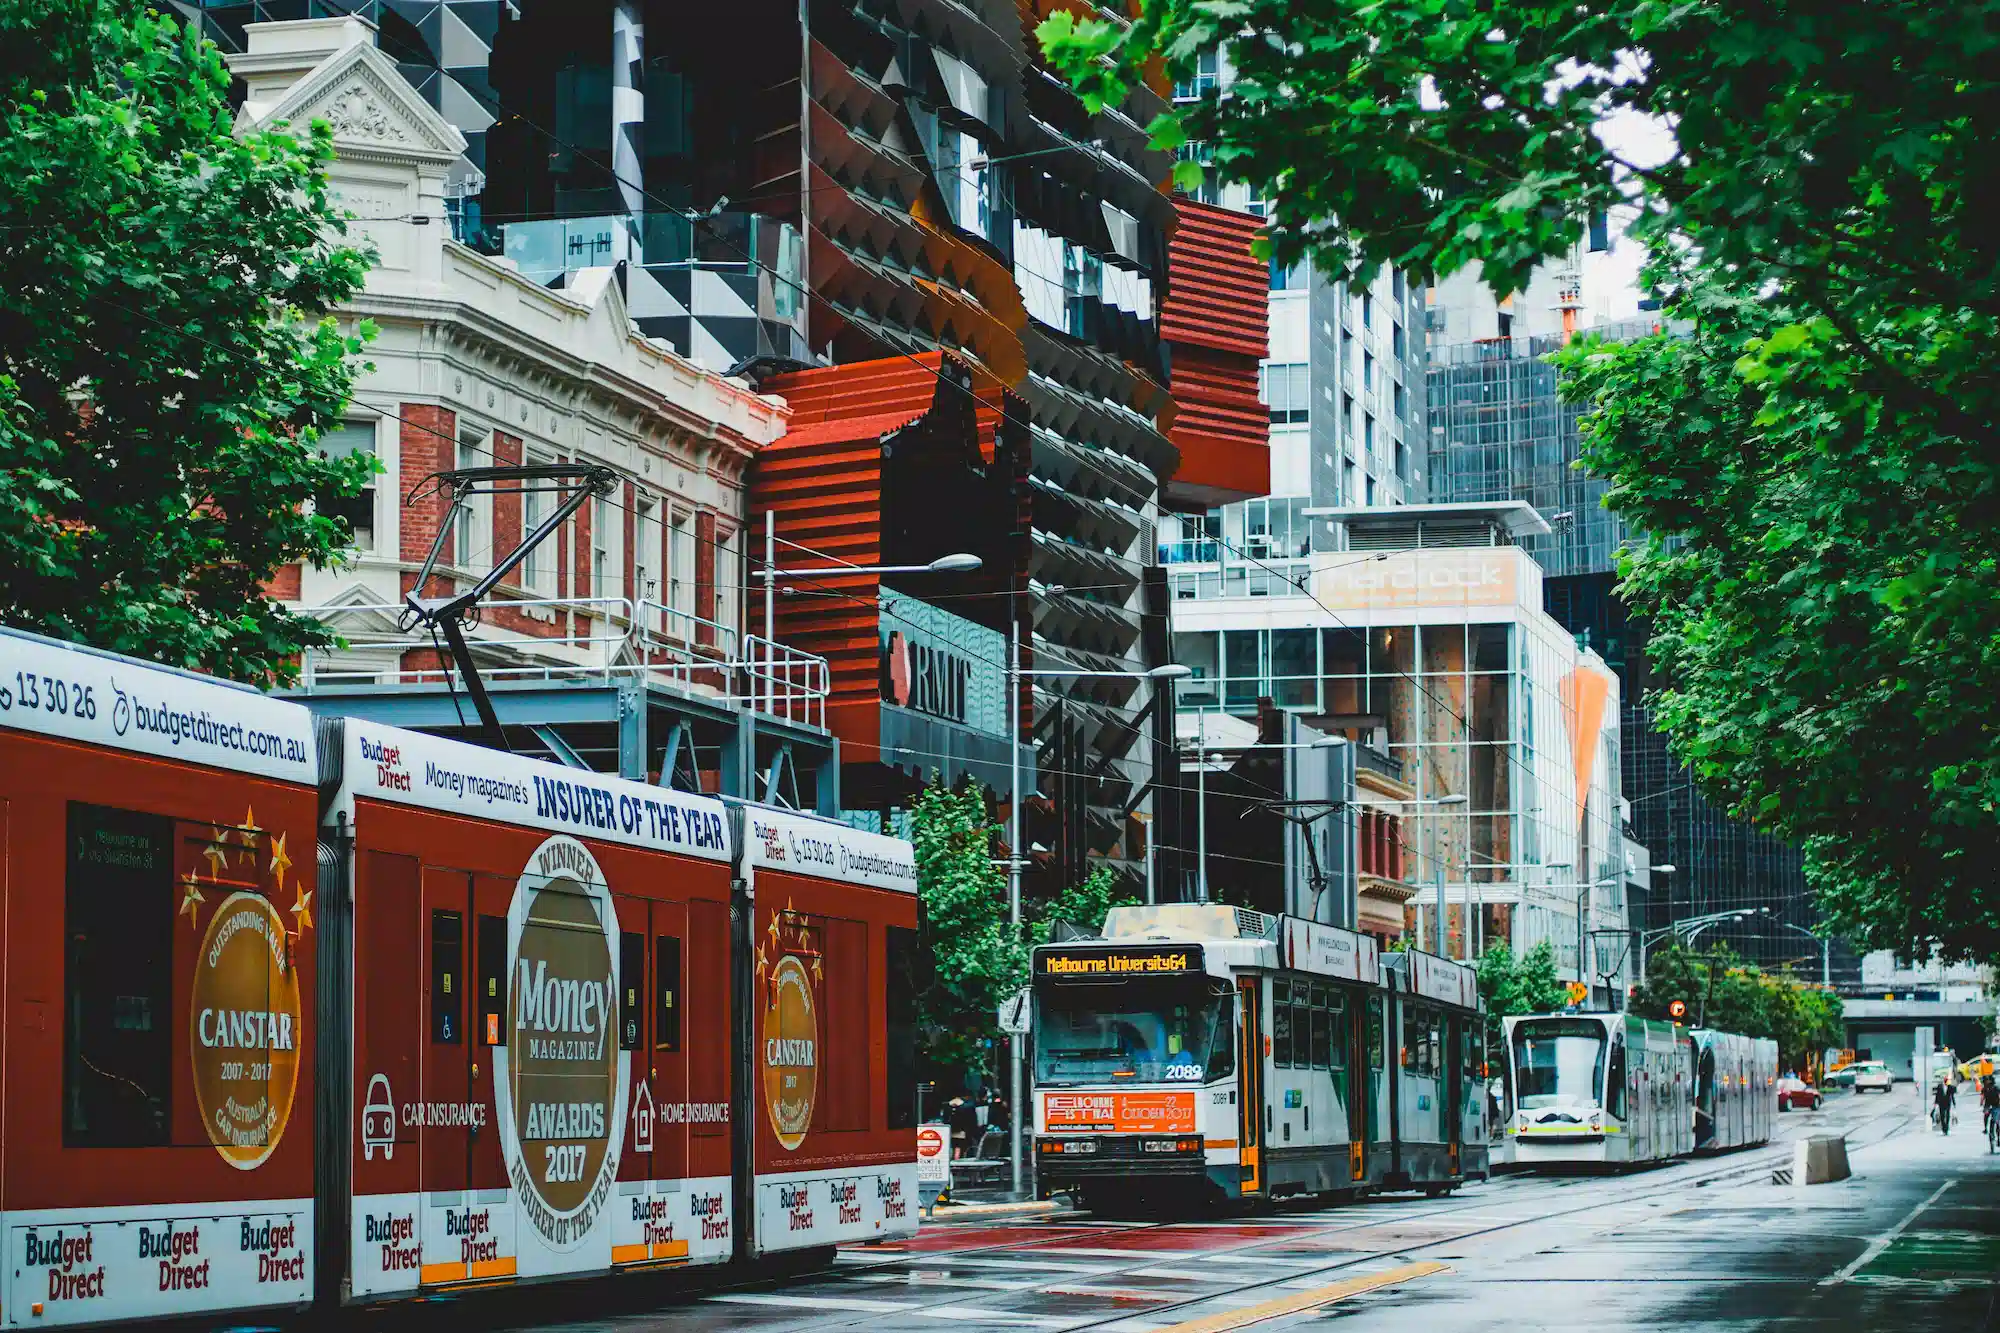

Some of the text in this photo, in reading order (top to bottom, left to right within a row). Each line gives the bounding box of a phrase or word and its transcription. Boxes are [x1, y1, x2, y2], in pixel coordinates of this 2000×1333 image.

[17, 671, 97, 721] 13 30 26
[915, 642, 971, 724] RMIT
[133, 696, 307, 764] budgetdirect.com.au
[360, 737, 402, 769] Budget
[377, 765, 412, 792] Direct
[425, 761, 725, 851] Money magazine's INSURER OF THE YEAR
[753, 821, 778, 847] Budget
[764, 841, 786, 862] Direct
[801, 838, 835, 866] 13 30 26
[537, 842, 595, 891] WINNER
[209, 911, 264, 968] OUTSTANDING
[1047, 956, 1106, 973] Melbourne
[518, 958, 613, 1061] Money
[199, 1008, 293, 1051] CANSTAR
[529, 1039, 597, 1062] MAGAZINE
[767, 1039, 814, 1067] CANSTAR
[220, 1063, 243, 1082] 2007
[250, 1063, 272, 1082] 2017
[1165, 1065, 1203, 1081] 2089
[225, 1096, 267, 1124] AUSTRALIA
[660, 1102, 729, 1123] HOME INSURANCE
[1213, 1093, 1227, 1105] 2089
[216, 1108, 232, 1141] CAR
[402, 1102, 487, 1127] CAR INSURANCE
[525, 1102, 605, 1139] AWARDS
[545, 1145, 587, 1183] 2017
[510, 1151, 616, 1245] INSURER OF THE YEAR
[780, 1187, 808, 1212] Budget
[830, 1183, 856, 1208] Budget
[877, 1178, 901, 1202] Budget
[632, 1196, 667, 1226] Budget
[691, 1192, 723, 1220] Budget
[790, 1209, 813, 1231] Direct
[839, 1204, 861, 1224] Direct
[885, 1199, 906, 1219] Direct
[366, 1214, 413, 1246] Budget
[446, 1209, 489, 1240] Budget
[643, 1222, 673, 1246] Direct
[702, 1218, 729, 1240] Direct
[25, 1228, 92, 1273] Budget
[139, 1226, 199, 1268] Budget
[240, 1221, 294, 1262] Budget
[460, 1237, 498, 1264] Direct
[258, 1251, 304, 1283] Direct
[381, 1244, 423, 1271] Direct
[48, 1267, 104, 1301] Direct
[158, 1259, 209, 1291] Direct
